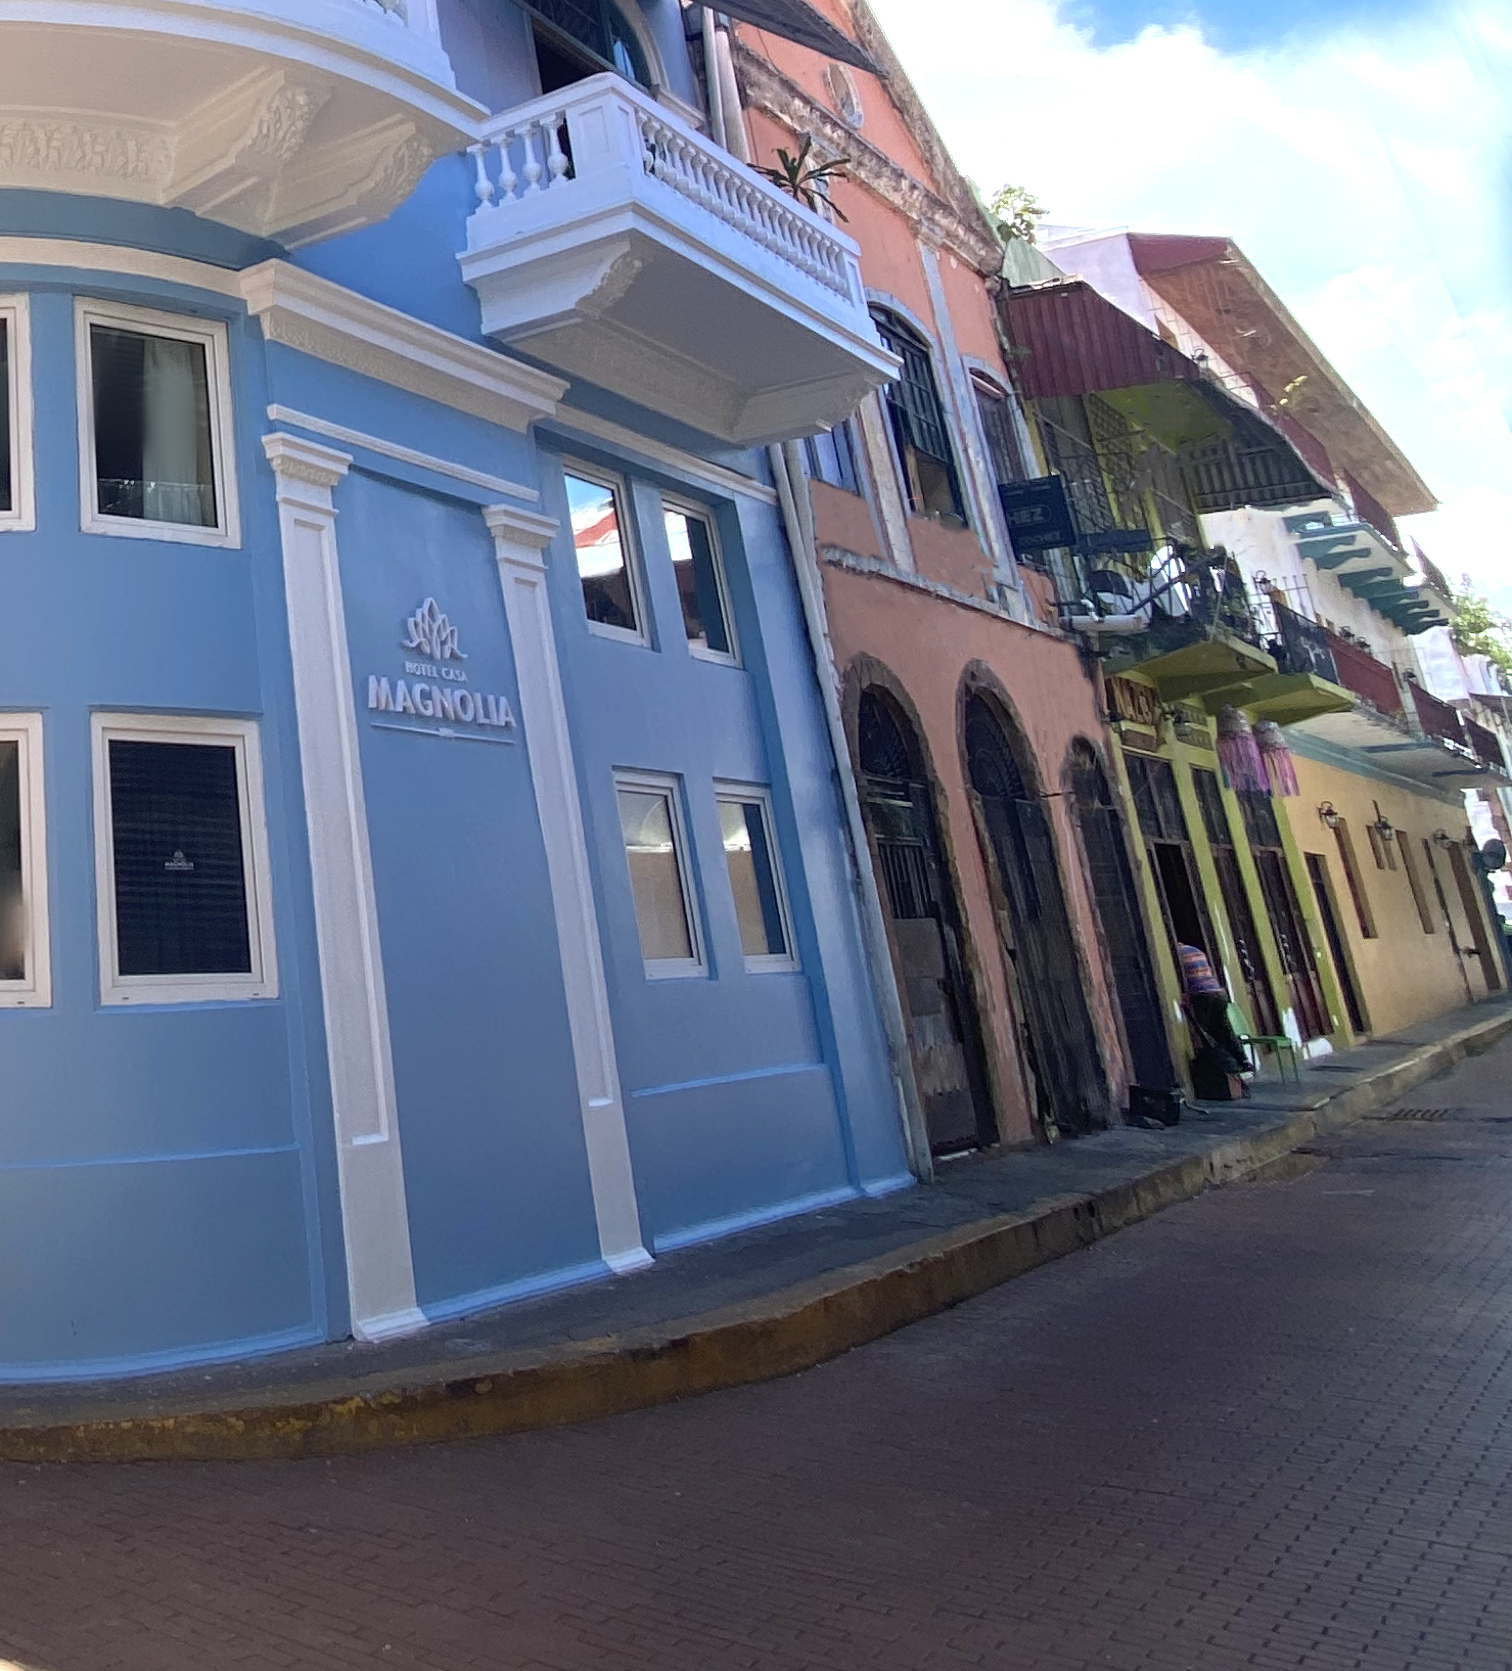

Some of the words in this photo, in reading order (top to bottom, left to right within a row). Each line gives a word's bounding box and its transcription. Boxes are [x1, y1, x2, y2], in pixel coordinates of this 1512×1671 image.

[405, 661, 438, 678] HOTEL
[442, 668, 468, 682] CASA
[368, 674, 517, 727] MAGNOLIA
